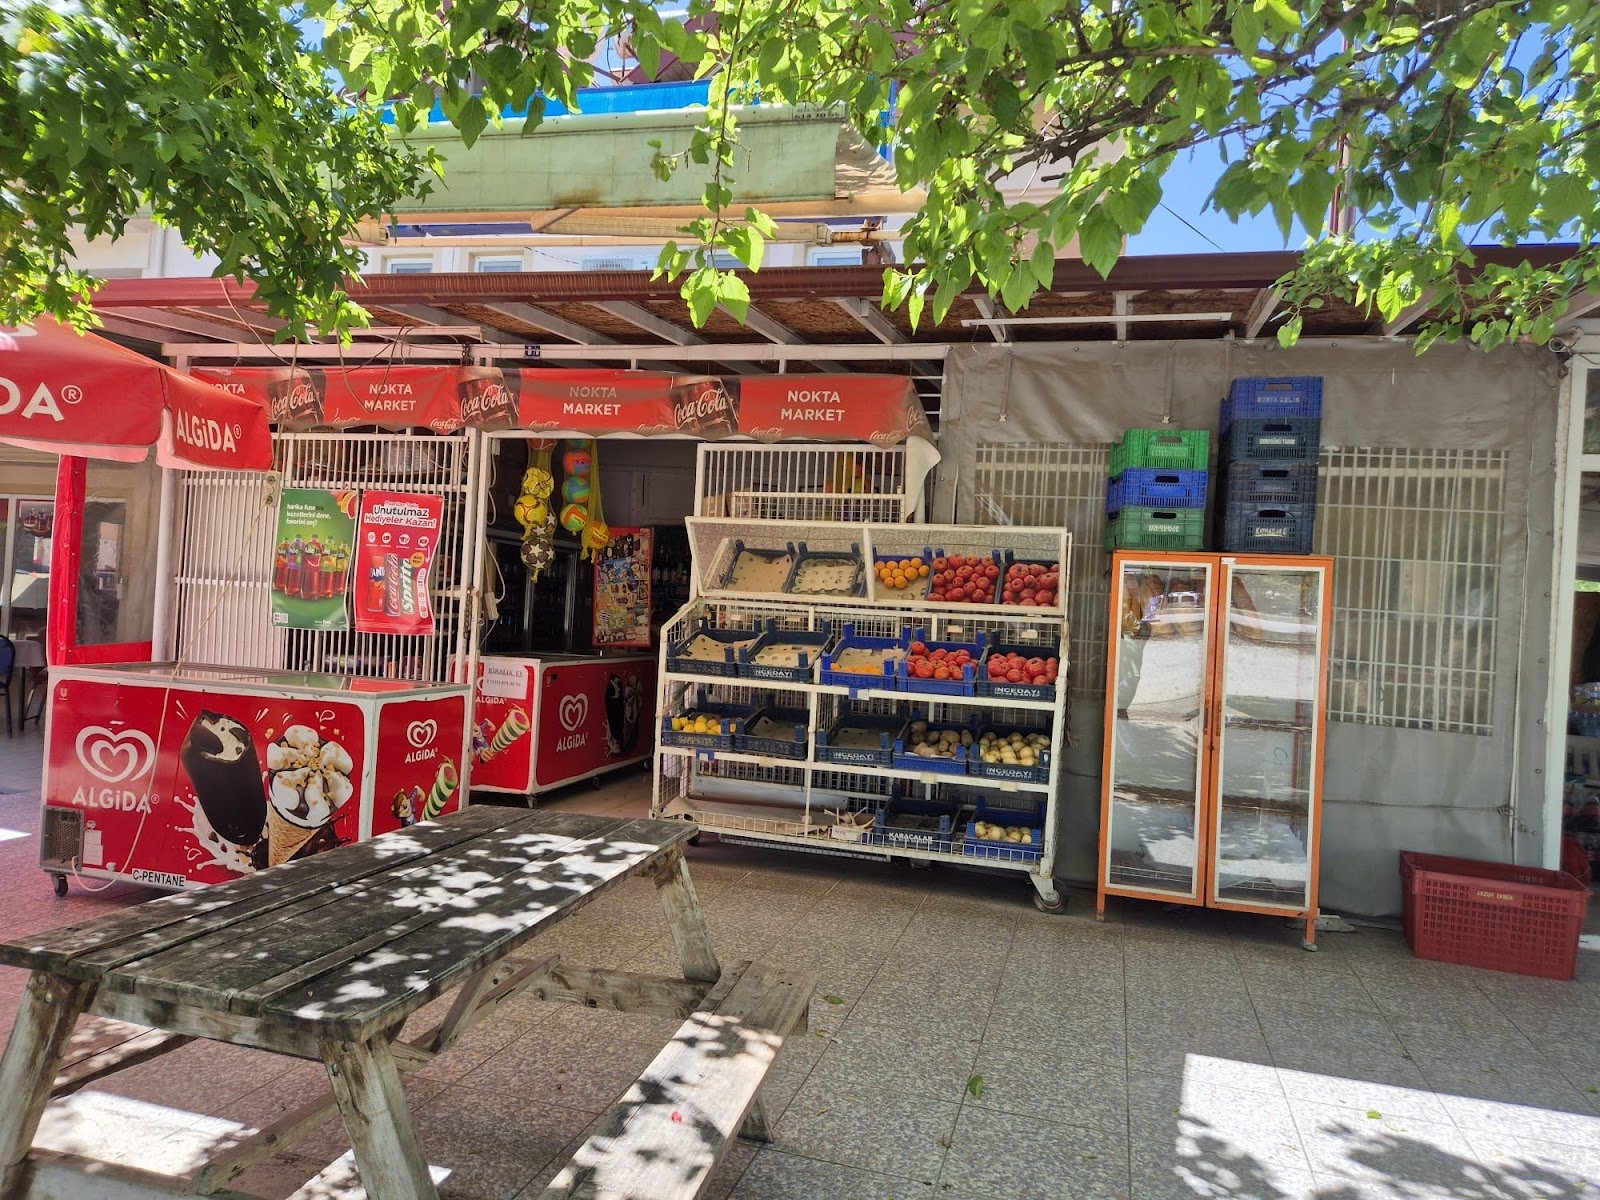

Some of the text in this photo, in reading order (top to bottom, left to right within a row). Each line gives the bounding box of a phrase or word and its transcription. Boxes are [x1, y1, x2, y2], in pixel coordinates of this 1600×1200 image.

[368, 383, 413, 395] NOKTA
[569, 386, 618, 398] NOKTA
[460, 383, 509, 422] Coca-Cola
[787, 390, 841, 404] NOKTA
[364, 400, 417, 411] MARKET
[563, 402, 622, 416] MARKET
[674, 387, 729, 430] Coca-Cola
[780, 408, 846, 422] MARKET
[373, 505, 429, 518] Unutulmaz
[365, 514, 437, 529] Hediyeler Kazan!
[132, 869, 186, 888] C-PENTANE
